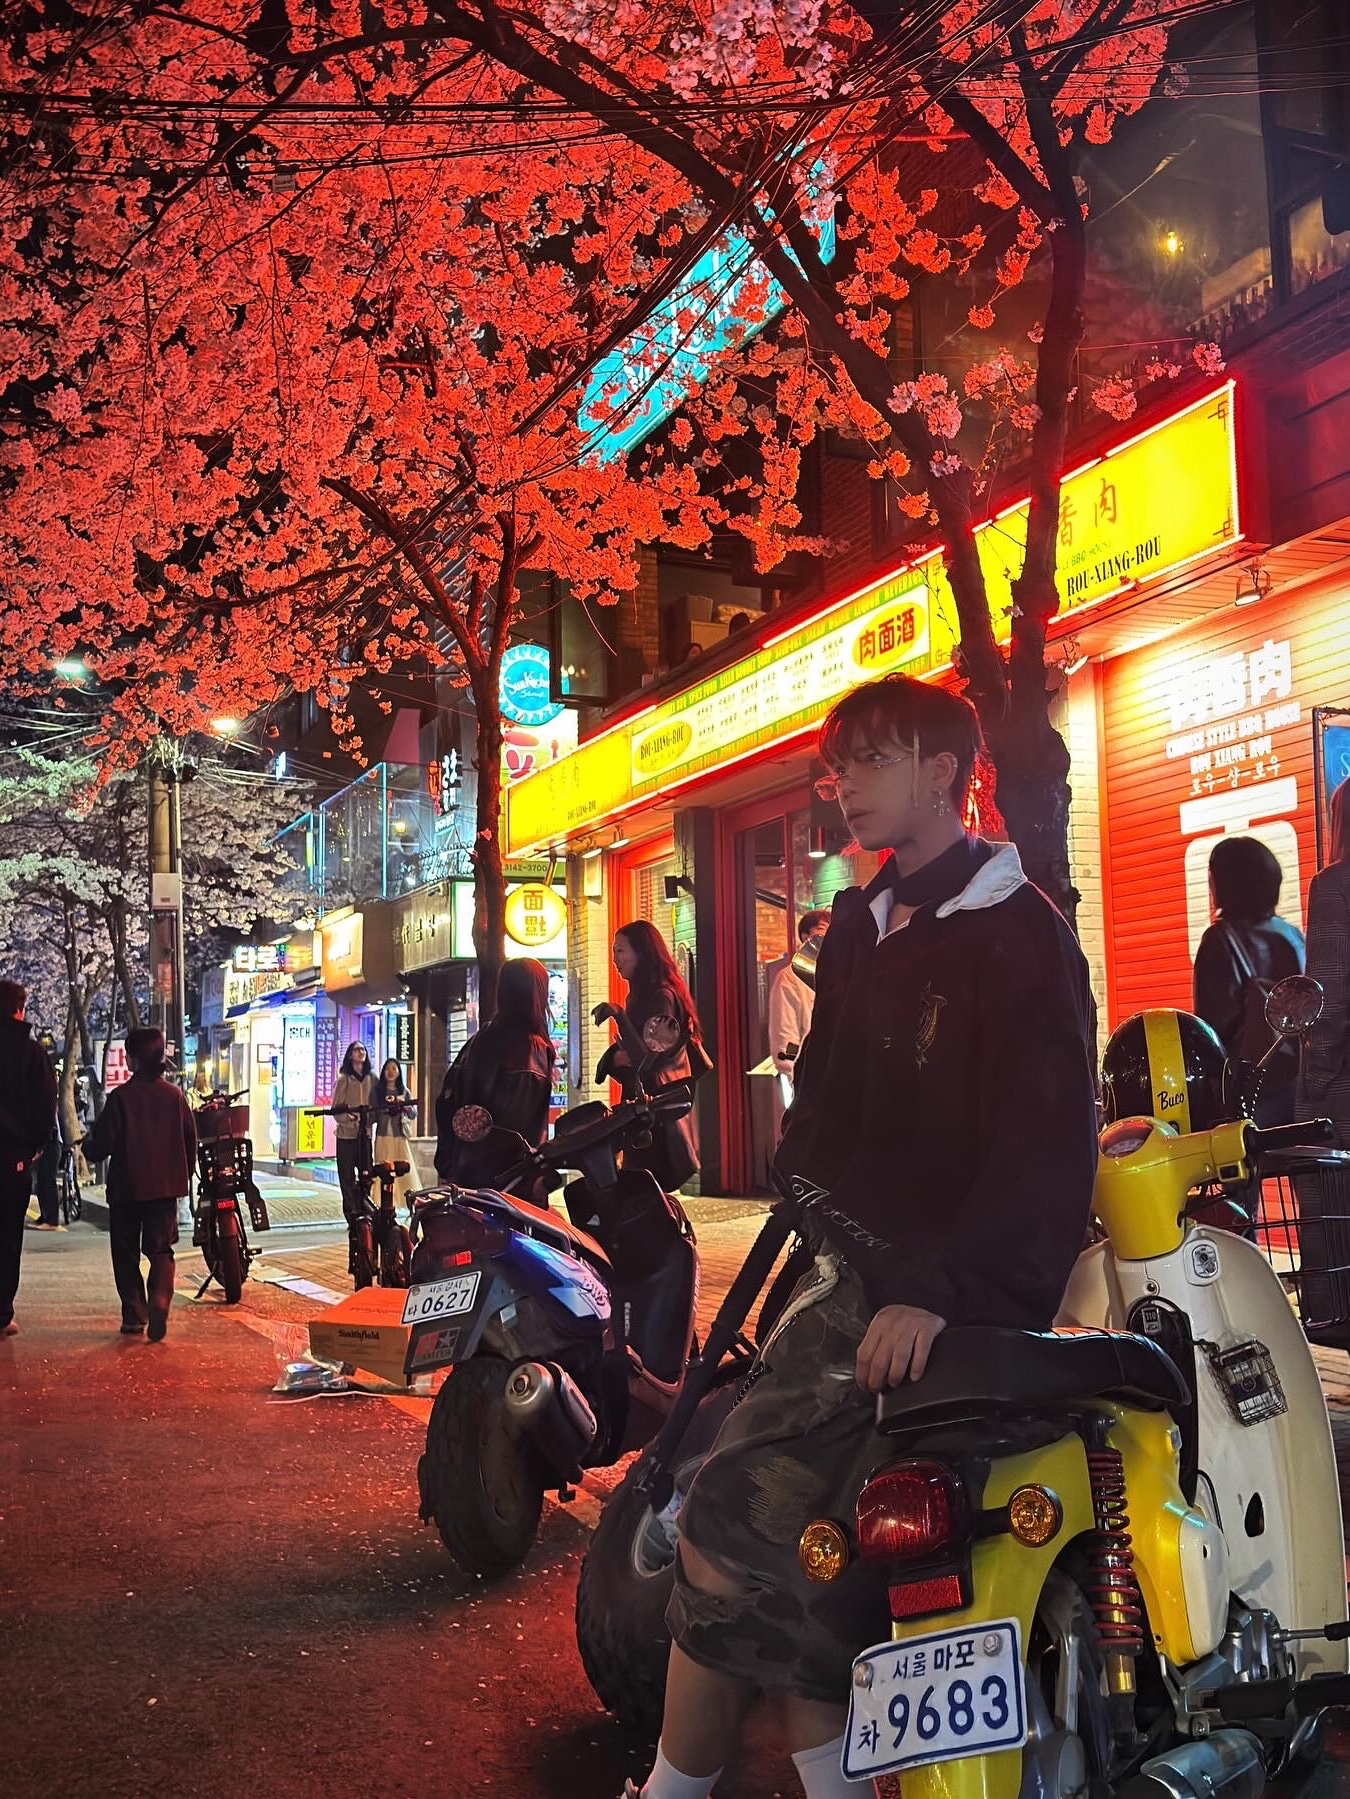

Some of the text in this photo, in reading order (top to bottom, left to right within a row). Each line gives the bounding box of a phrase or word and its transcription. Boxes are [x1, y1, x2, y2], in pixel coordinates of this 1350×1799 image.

[1067, 535, 1162, 597] ROU-XIANG-ROU
[859, 607, 915, 664] 肉面酒
[1206, 722, 1237, 748] STYLE
[235, 945, 280, 969] 타로
[1157, 1091, 1184, 1110] Buco
[421, 1288, 471, 1314] 0627
[892, 1639, 975, 1680] 서울 마포
[857, 1674, 1009, 1754] 차 9683
